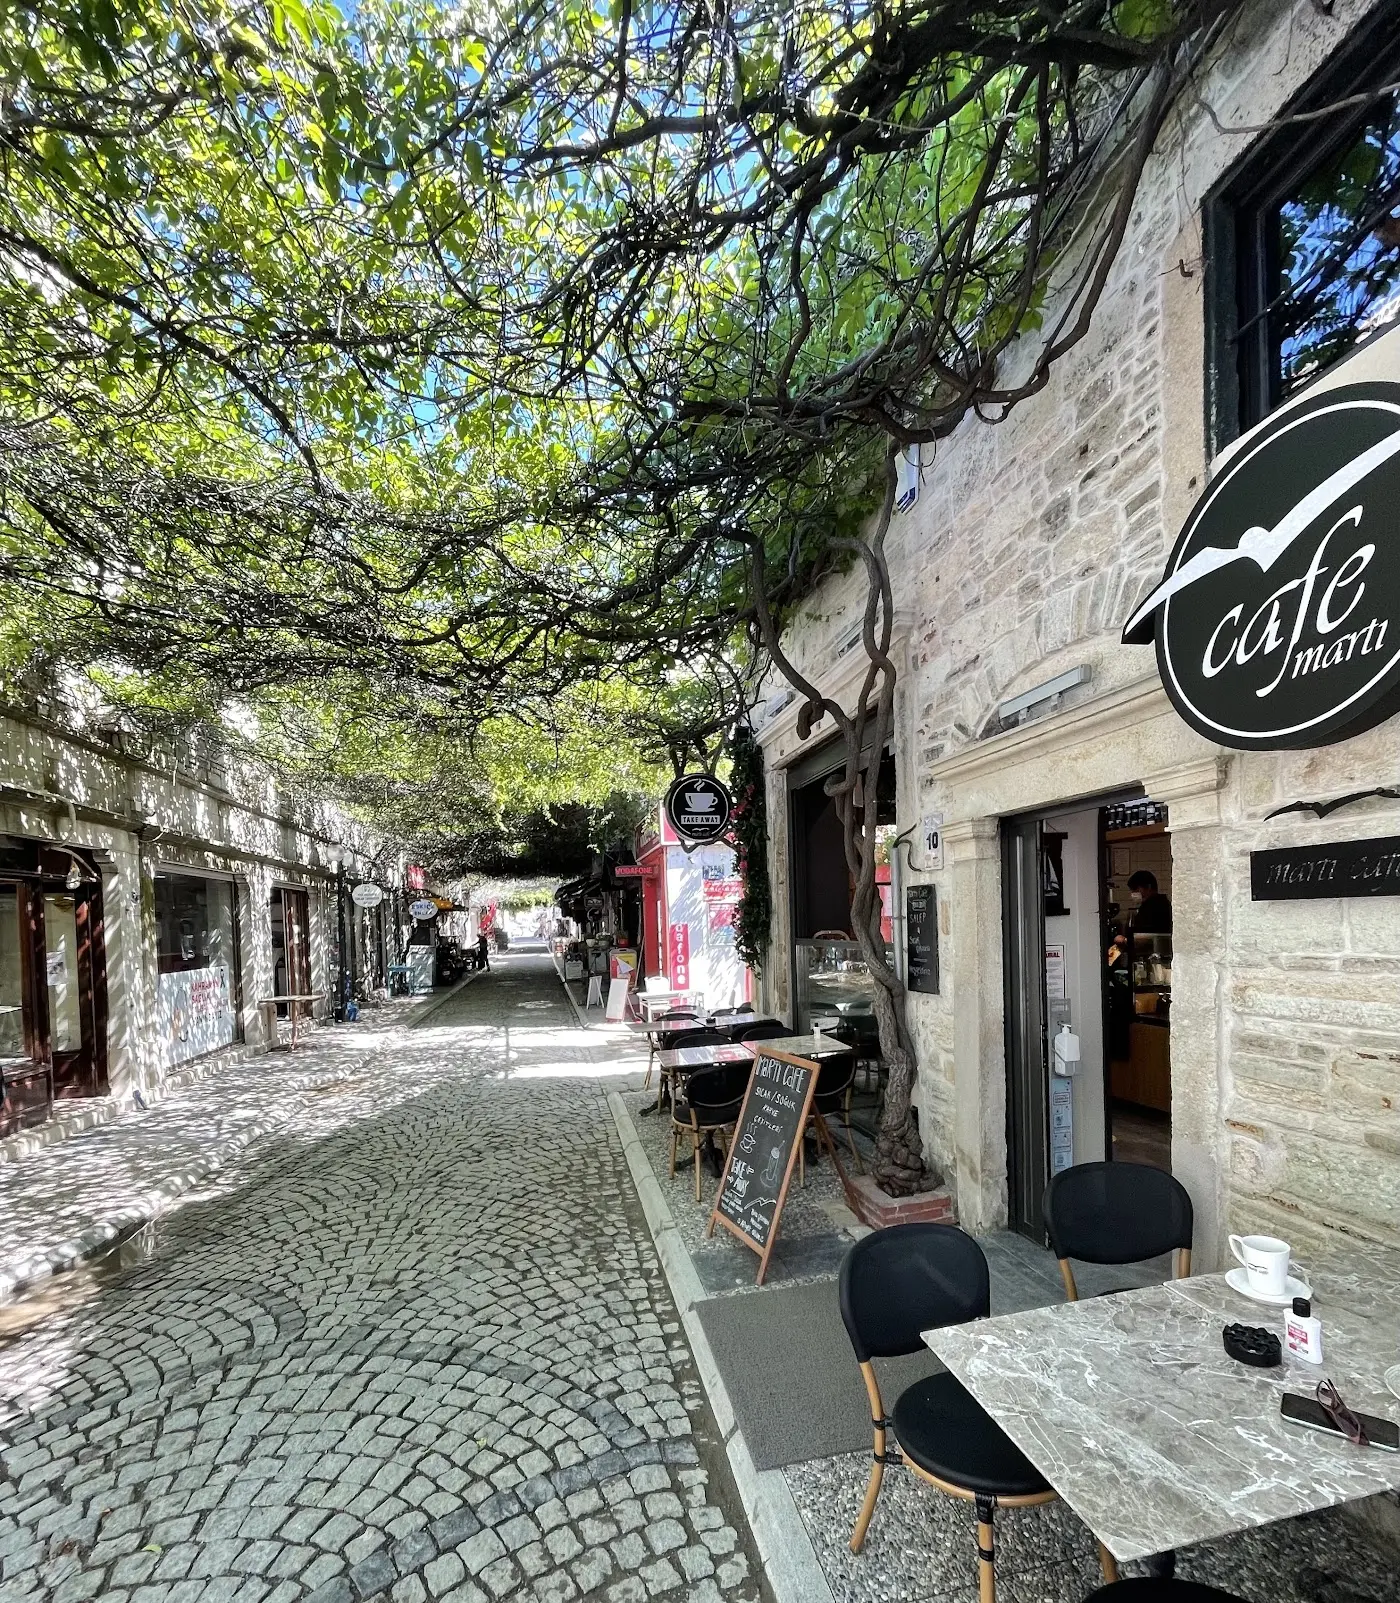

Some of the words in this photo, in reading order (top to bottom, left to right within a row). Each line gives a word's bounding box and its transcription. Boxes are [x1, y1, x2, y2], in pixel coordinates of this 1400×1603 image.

[1202, 504, 1376, 698] cafe
[926, 831, 939, 850] 10
[615, 866, 653, 875] VODAFONE
